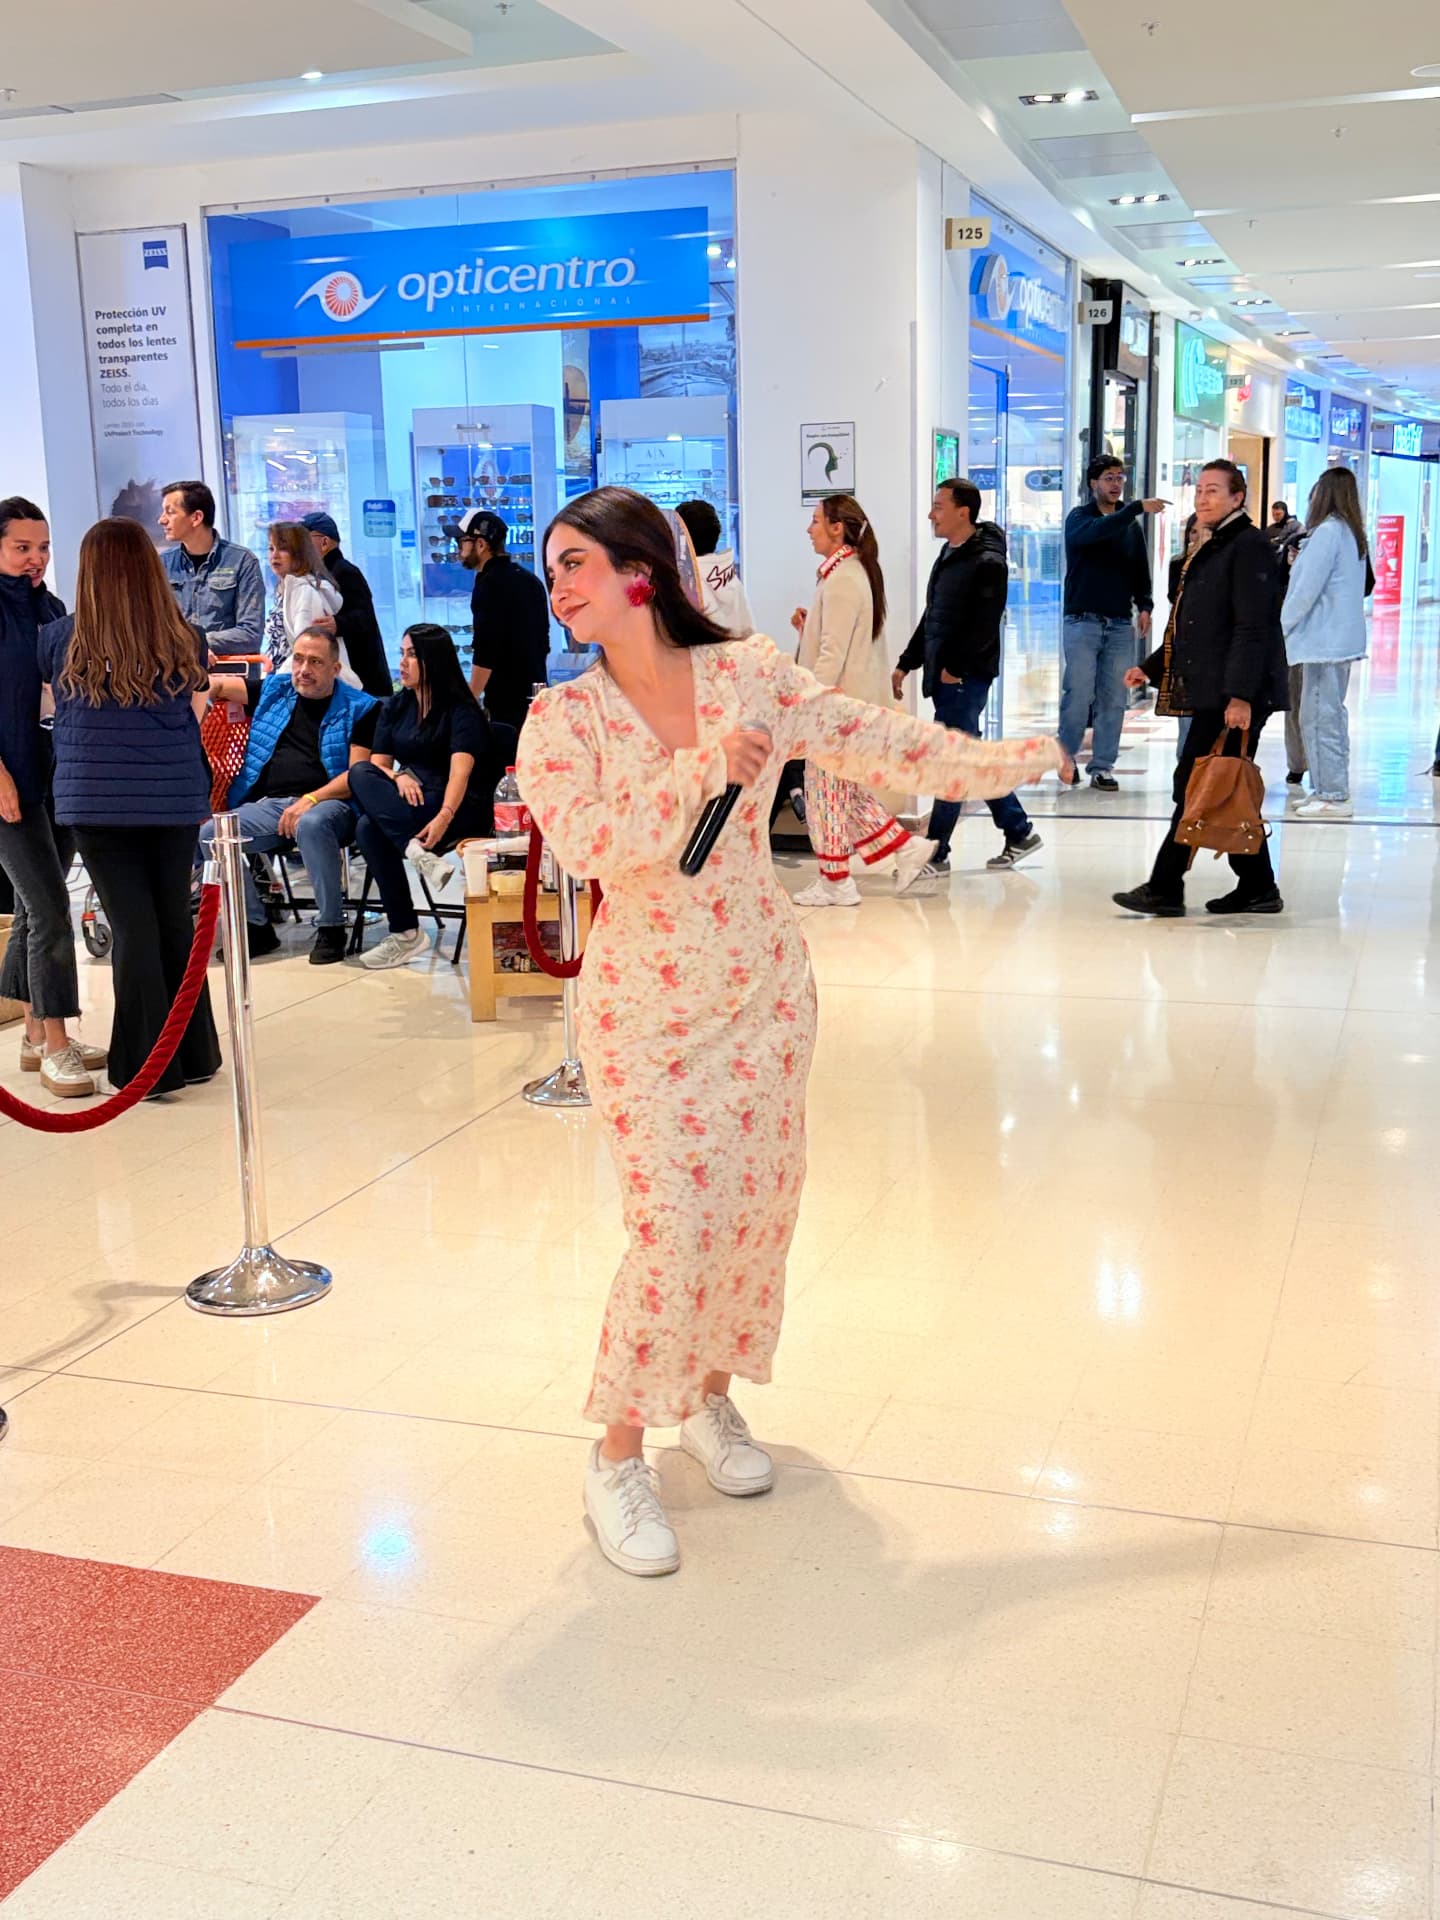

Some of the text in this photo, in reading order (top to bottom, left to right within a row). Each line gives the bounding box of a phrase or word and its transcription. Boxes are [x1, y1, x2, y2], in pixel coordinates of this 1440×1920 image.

[958, 228, 983, 240] 125
[398, 256, 636, 312] opticentro
[451, 297, 631, 313] INTERNACIONAL
[95, 306, 166, 320] Protección UV
[1088, 308, 1107, 318] 126
[96, 323, 142, 336] completa
[97, 336, 177, 349] todos los lentes
[98, 352, 168, 365] transparentes
[100, 368, 131, 379] ZEISS.
[101, 383, 122, 393] Todo
[124, 382, 132, 392] el
[102, 399, 126, 408] todos
[128, 397, 140, 407] los
